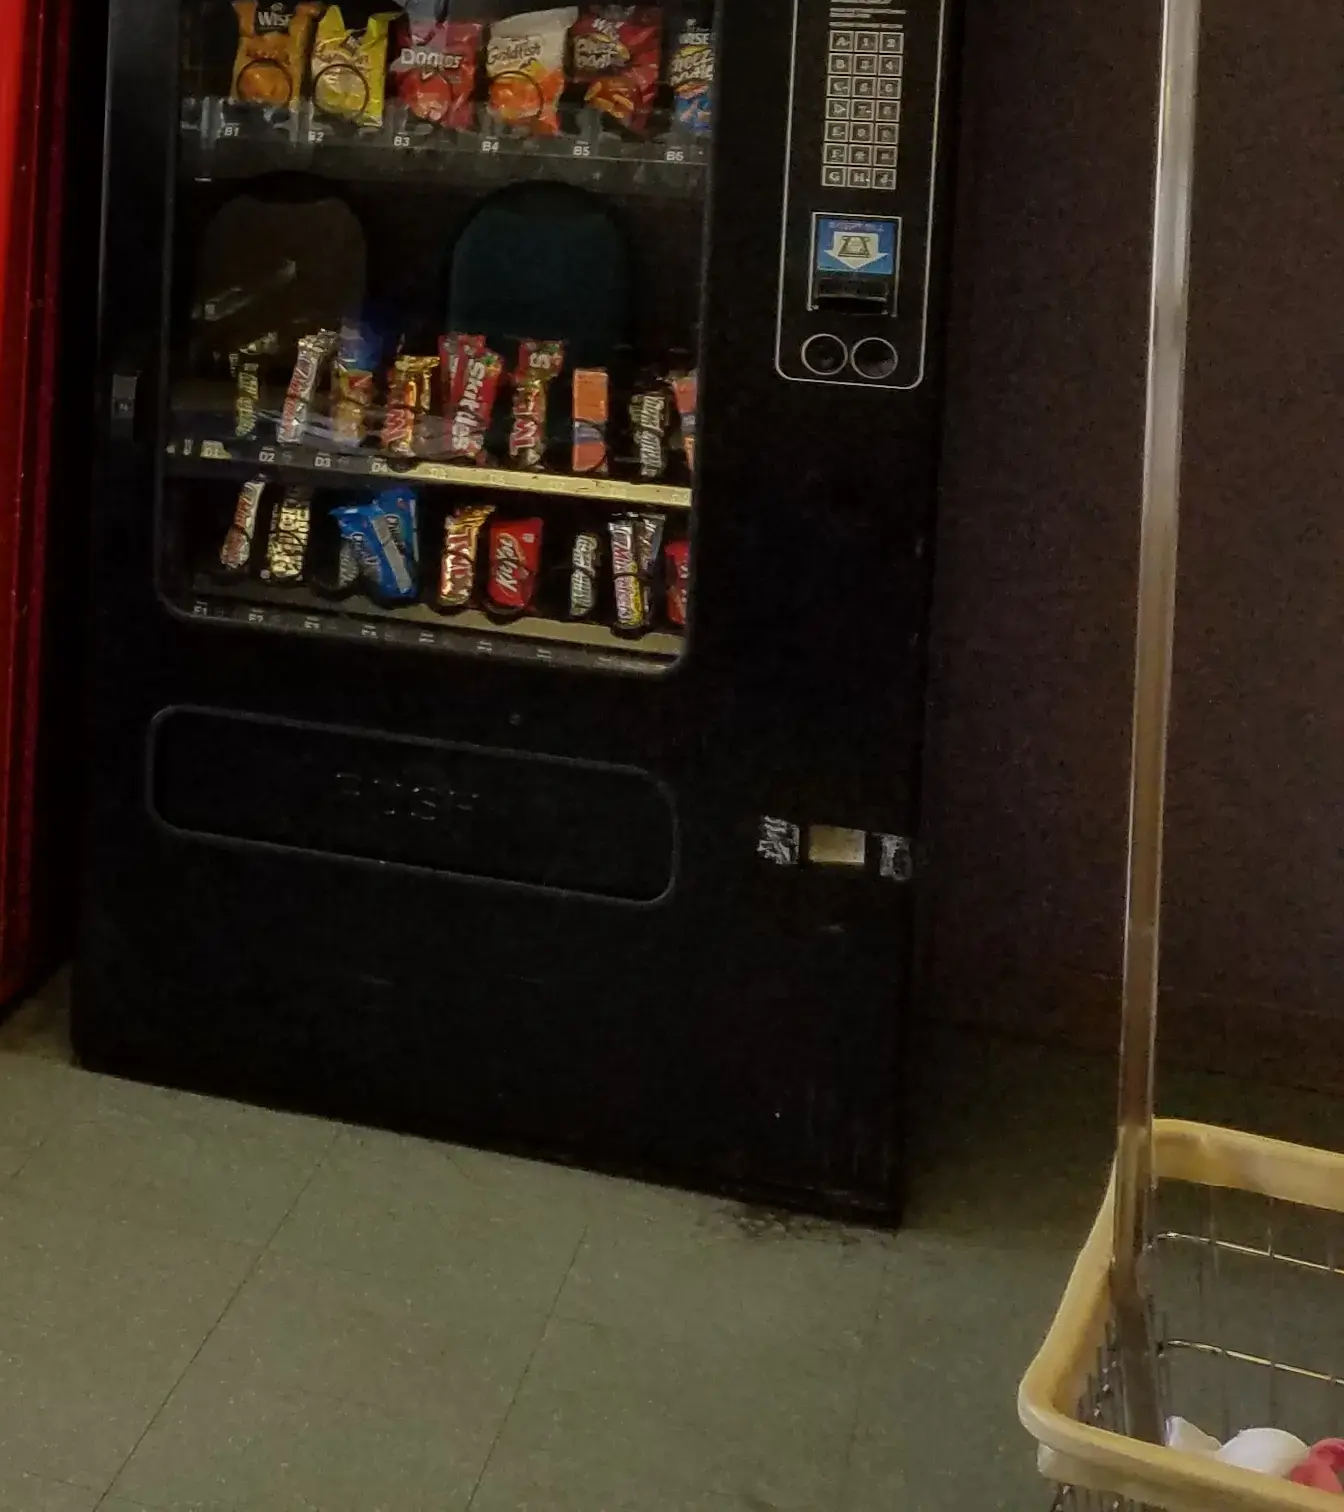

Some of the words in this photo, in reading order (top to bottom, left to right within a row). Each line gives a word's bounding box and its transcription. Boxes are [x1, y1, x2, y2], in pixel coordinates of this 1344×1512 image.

[223, 126, 240, 137] B1
[308, 131, 325, 143] B2
[393, 136, 411, 147] B3
[481, 141, 500, 152] B4
[573, 146, 591, 157] B5
[666, 150, 685, 161] B6
[258, 451, 275, 462] D2
[315, 456, 331, 467] D3
[372, 460, 388, 472] D4
